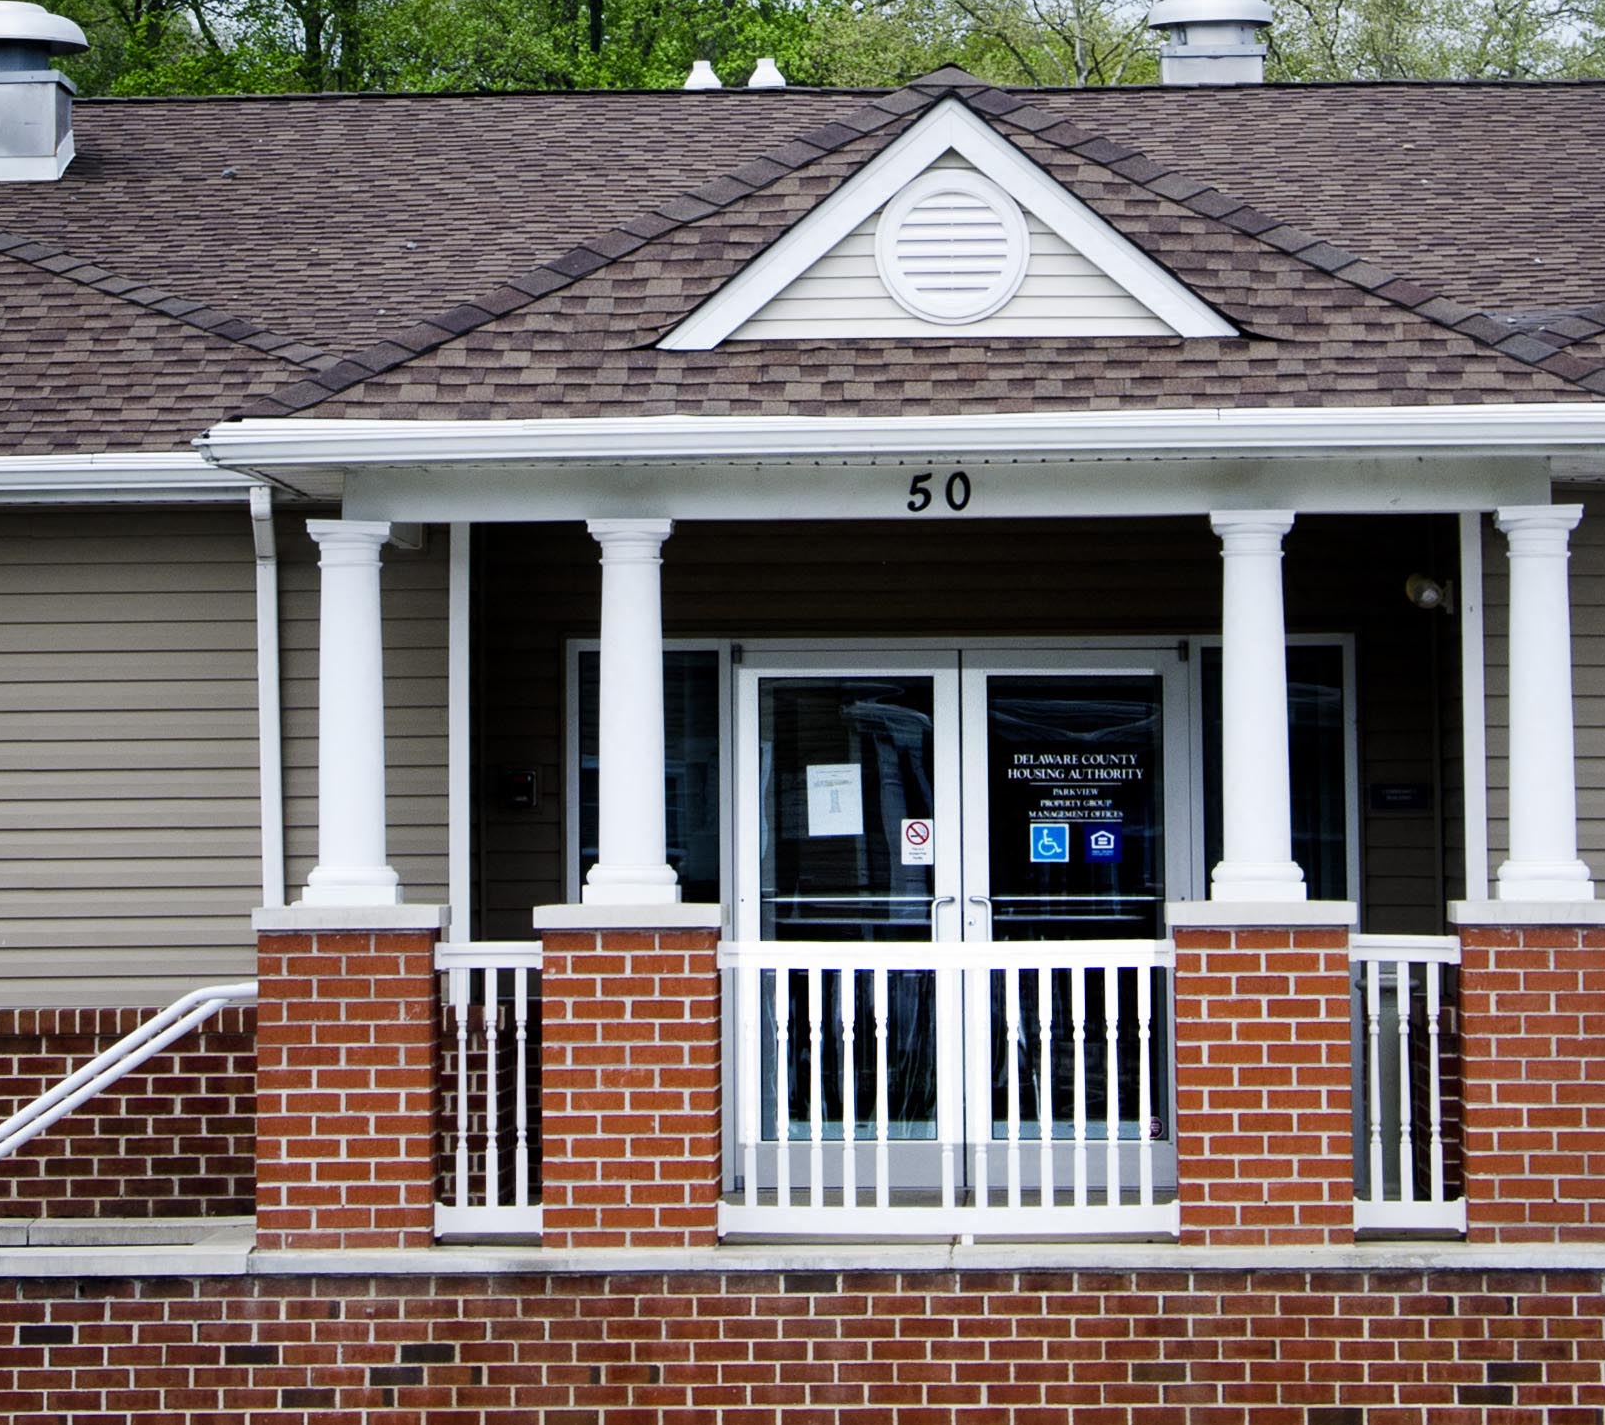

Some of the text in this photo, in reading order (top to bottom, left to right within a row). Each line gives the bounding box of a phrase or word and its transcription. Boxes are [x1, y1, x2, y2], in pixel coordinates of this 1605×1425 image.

[907, 471, 971, 512] 50
[1014, 754, 1138, 765] DELAWARE COUNTY
[1008, 768, 1144, 780] HOUSING AUTHORITY
[1052, 788, 1099, 796] PARKVIEW
[1040, 799, 1113, 807] PROPERTY GROUP
[1028, 810, 1124, 818] MANAGEMENT OFFICES
